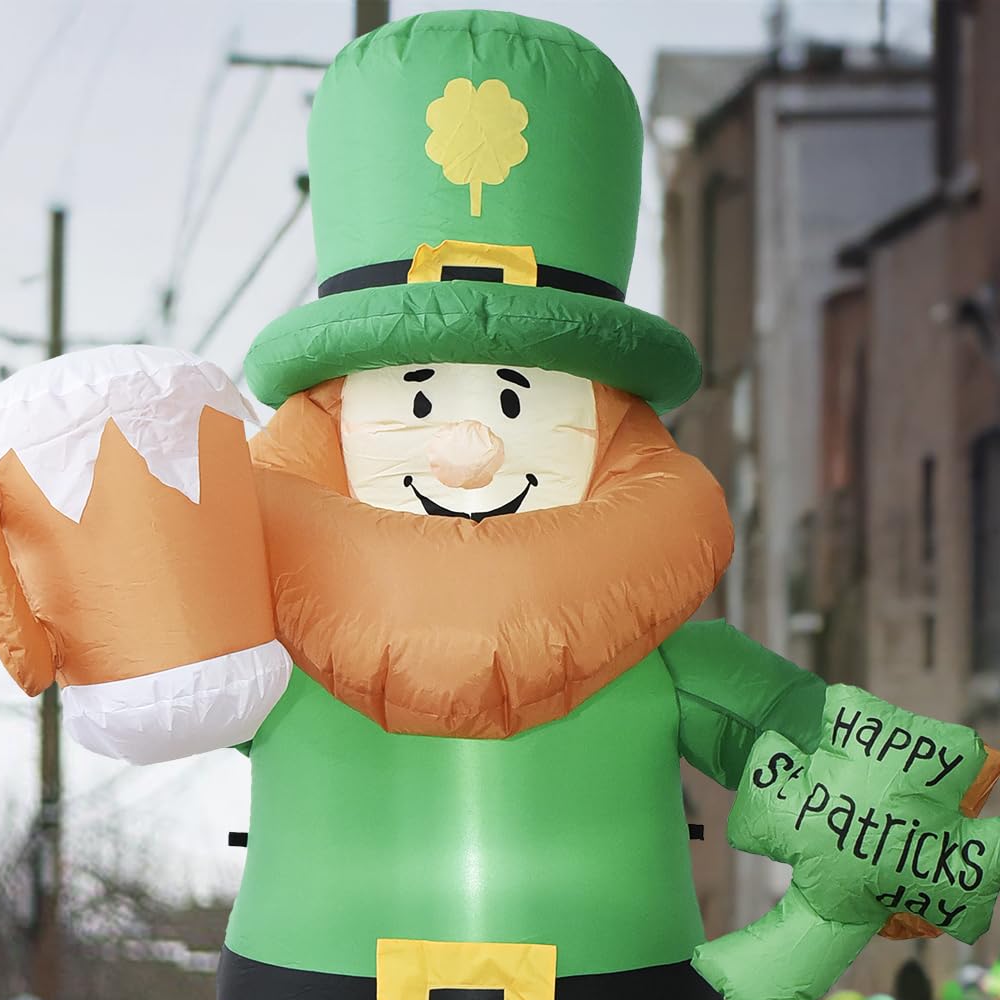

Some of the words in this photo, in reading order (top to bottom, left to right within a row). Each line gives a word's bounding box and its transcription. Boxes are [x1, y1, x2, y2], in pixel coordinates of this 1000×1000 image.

[831, 706, 964, 786] Happy
[753, 752, 804, 799] St
[875, 885, 967, 927] day
